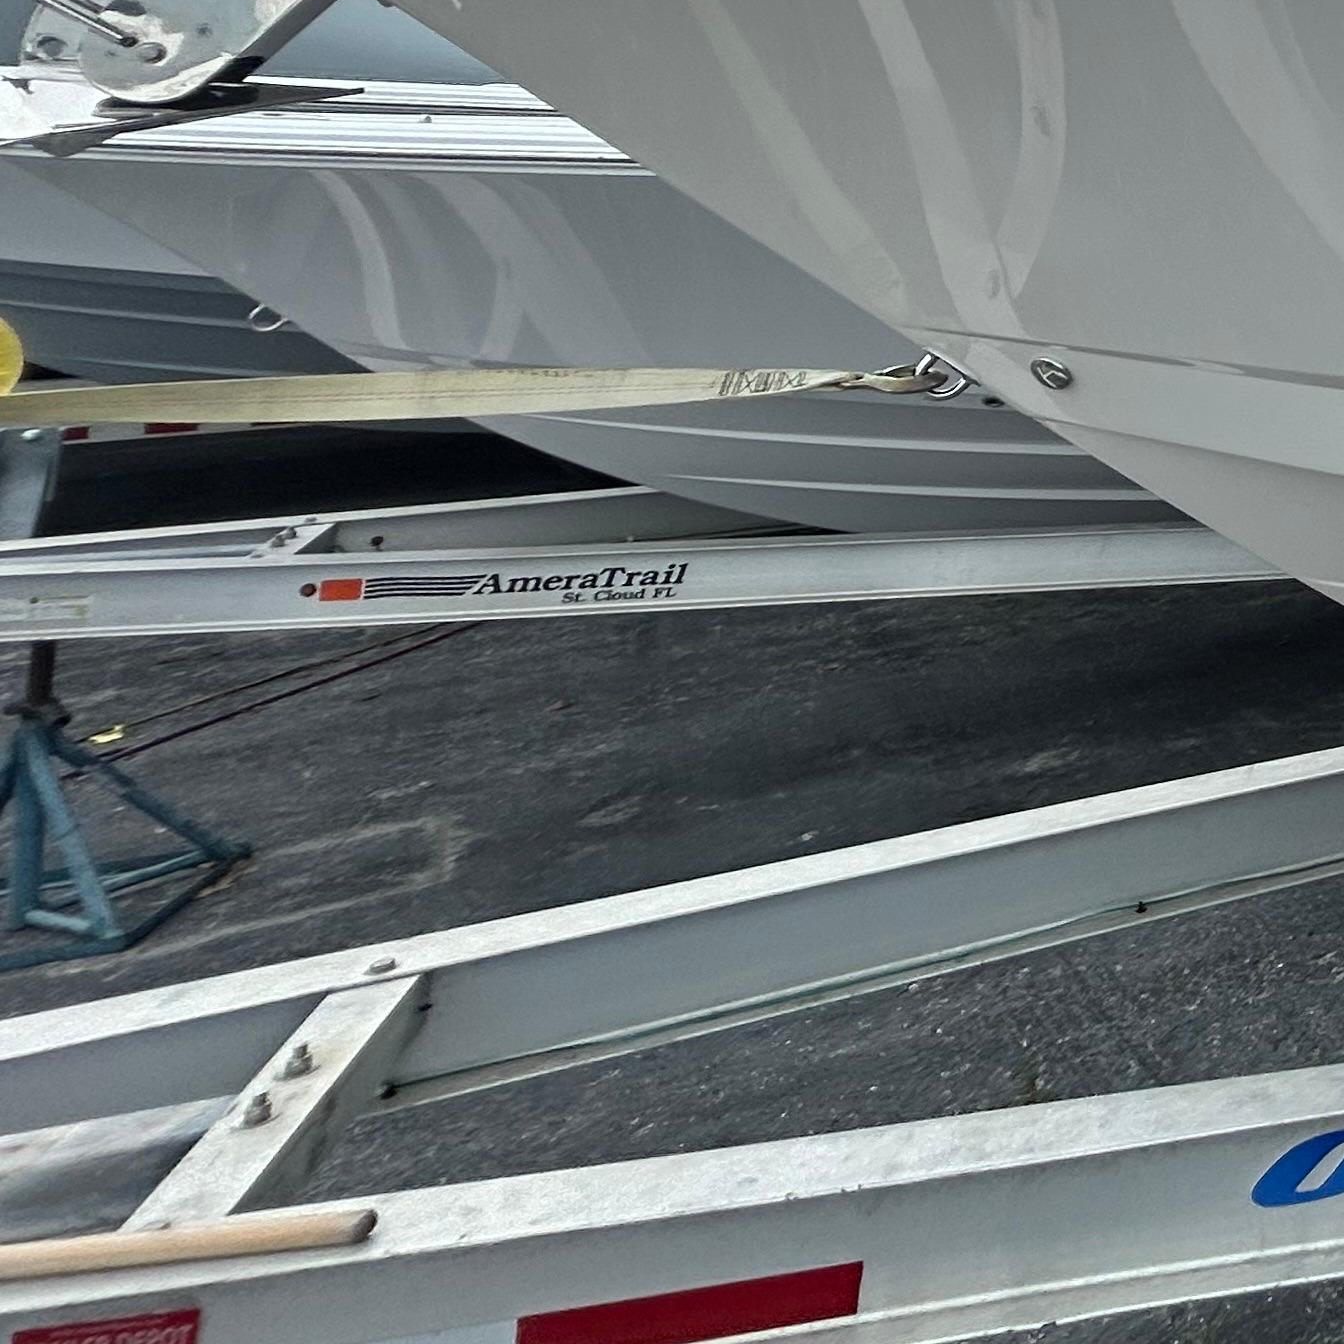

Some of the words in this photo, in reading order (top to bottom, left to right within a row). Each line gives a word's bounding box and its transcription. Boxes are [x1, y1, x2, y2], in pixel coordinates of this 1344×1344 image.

[472, 563, 689, 595] AmeraTrail
[594, 588, 646, 603] Cloud
[652, 586, 677, 599] FL
